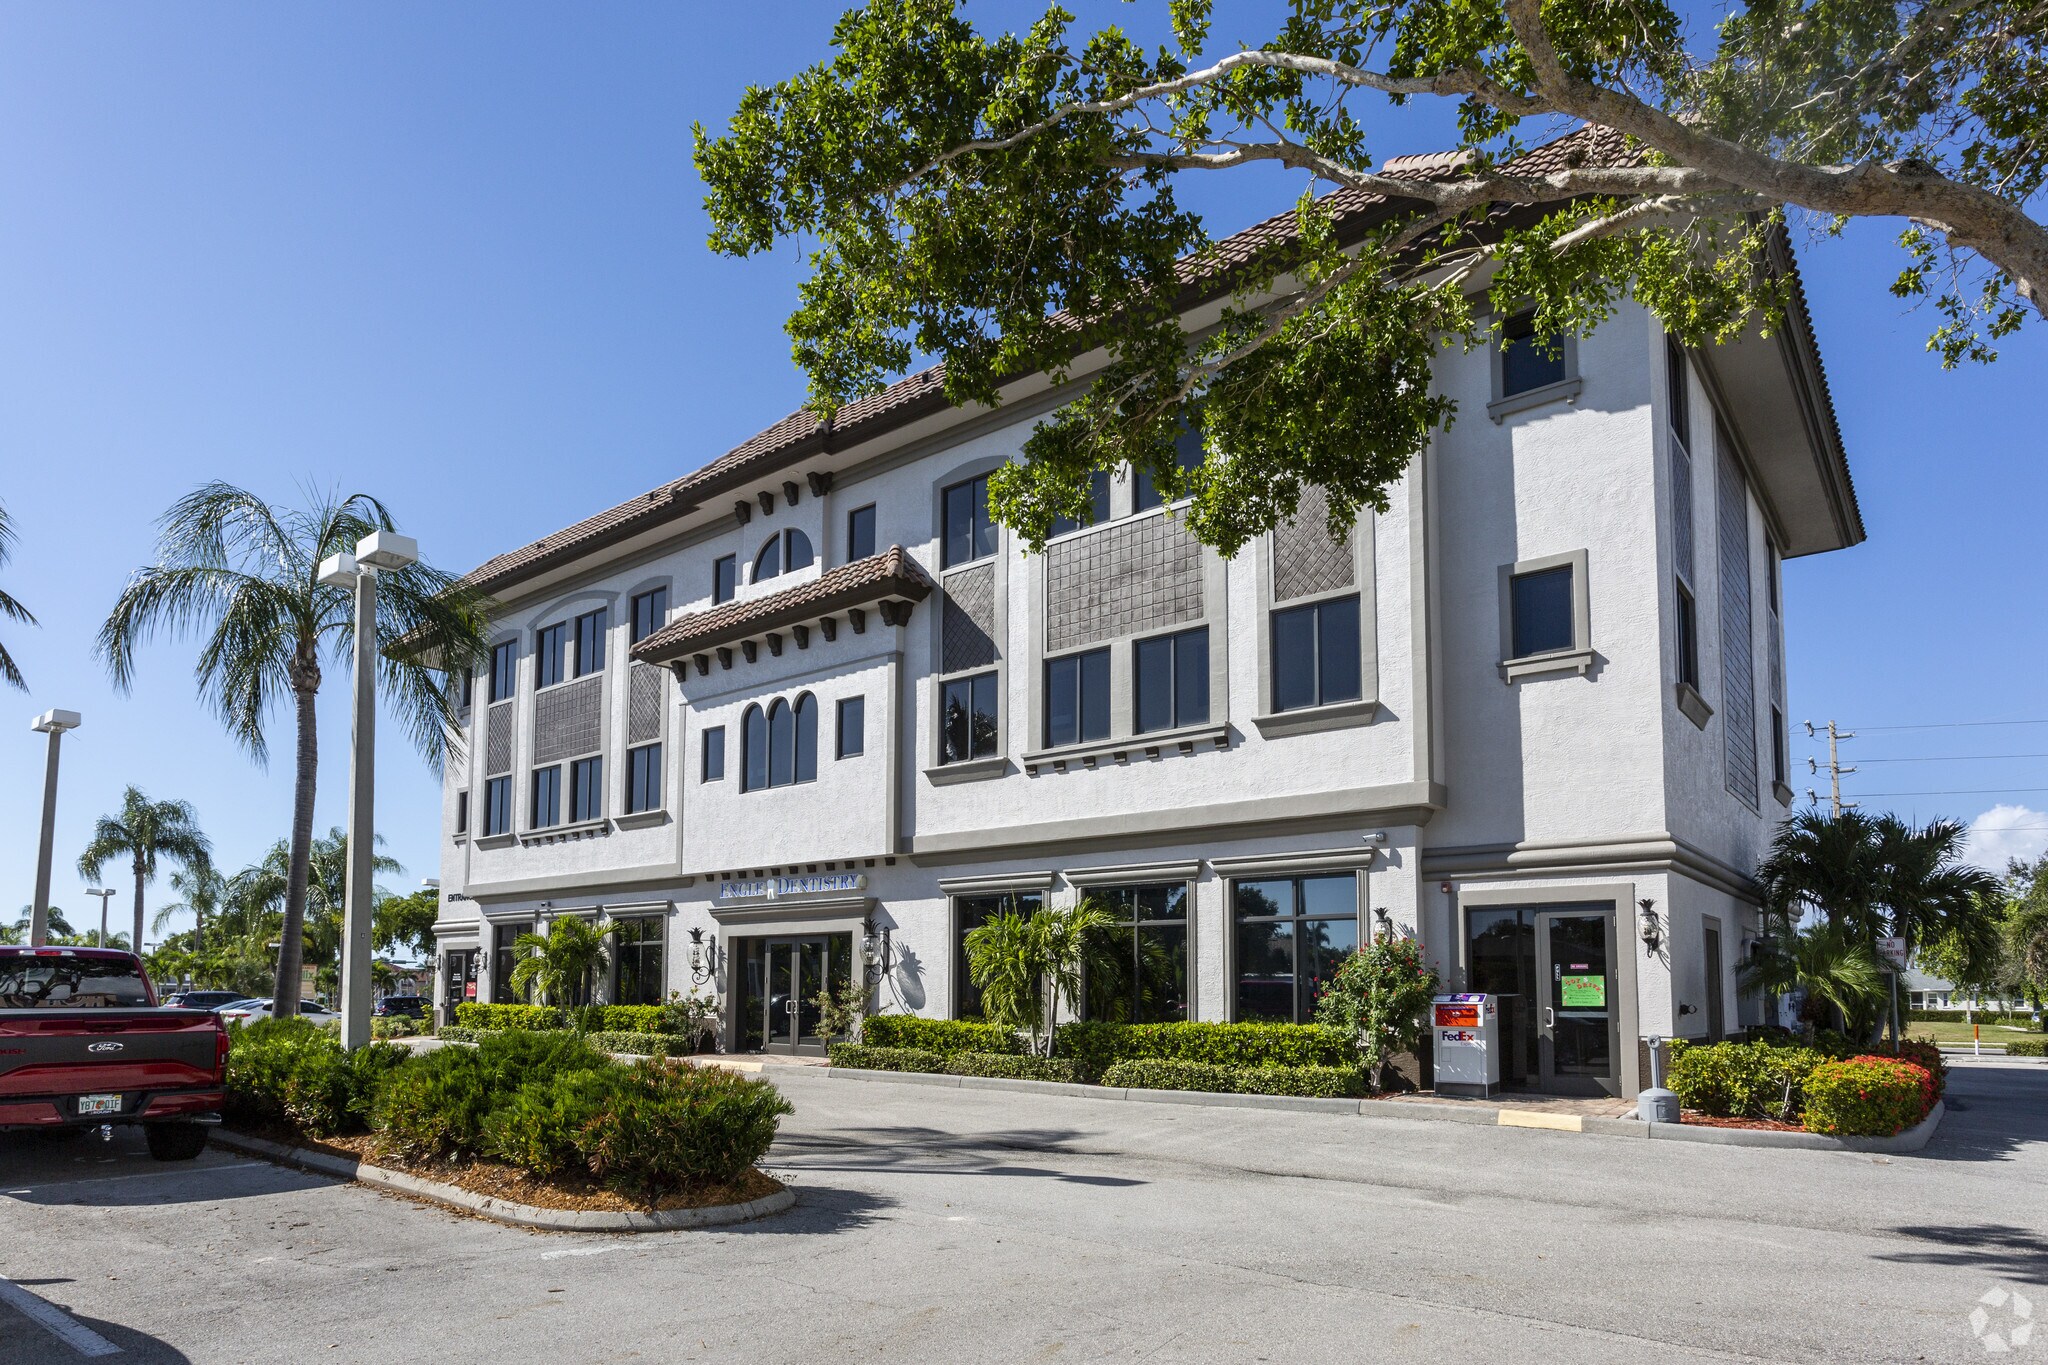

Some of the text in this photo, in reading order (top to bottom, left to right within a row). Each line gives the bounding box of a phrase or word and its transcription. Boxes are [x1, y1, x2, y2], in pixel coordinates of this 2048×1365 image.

[719, 874, 858, 899] ENGLE DENTISTRY
[1442, 1031, 1474, 1041] FedEx
